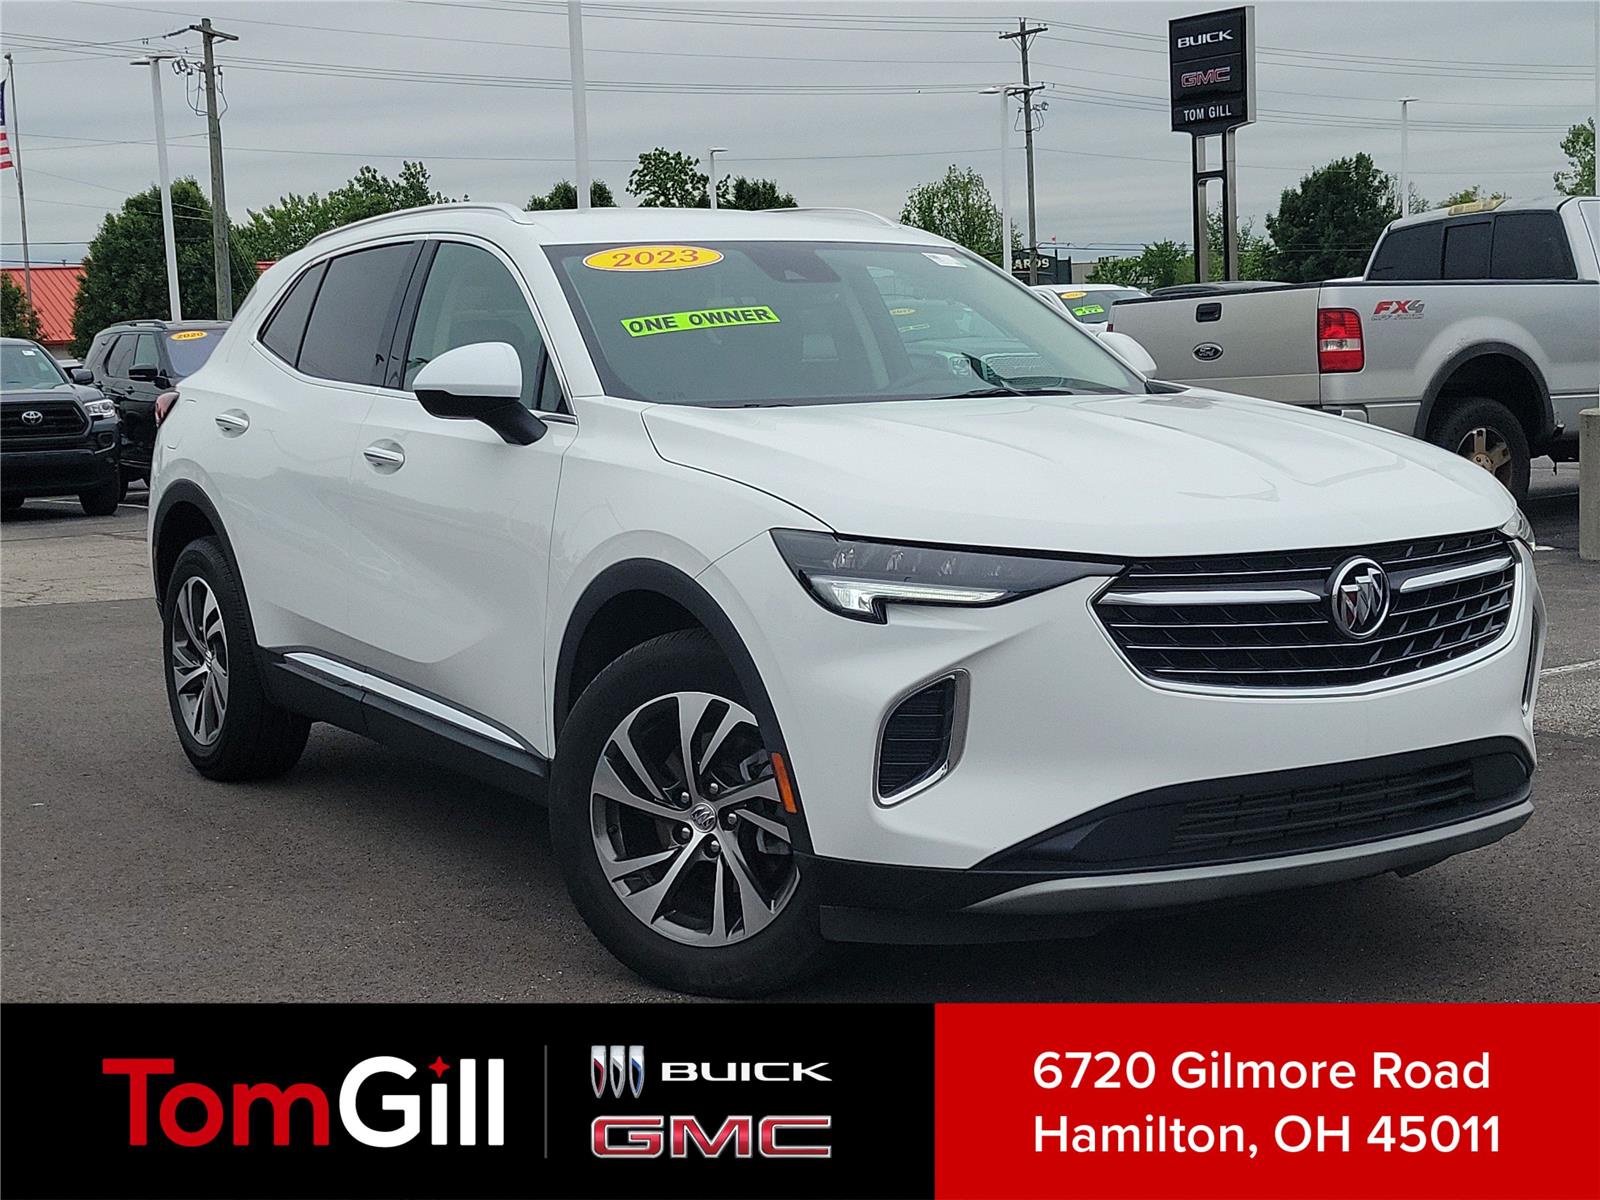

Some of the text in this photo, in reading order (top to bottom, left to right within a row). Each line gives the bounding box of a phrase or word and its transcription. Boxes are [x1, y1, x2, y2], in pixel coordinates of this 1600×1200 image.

[1177, 29, 1234, 49] BUICK
[1181, 66, 1231, 88] GMC
[1184, 104, 1232, 121] TOM GILL
[612, 249, 700, 268] 2023
[1373, 299, 1425, 315] FX4
[628, 308, 772, 334] ONE OWNER
